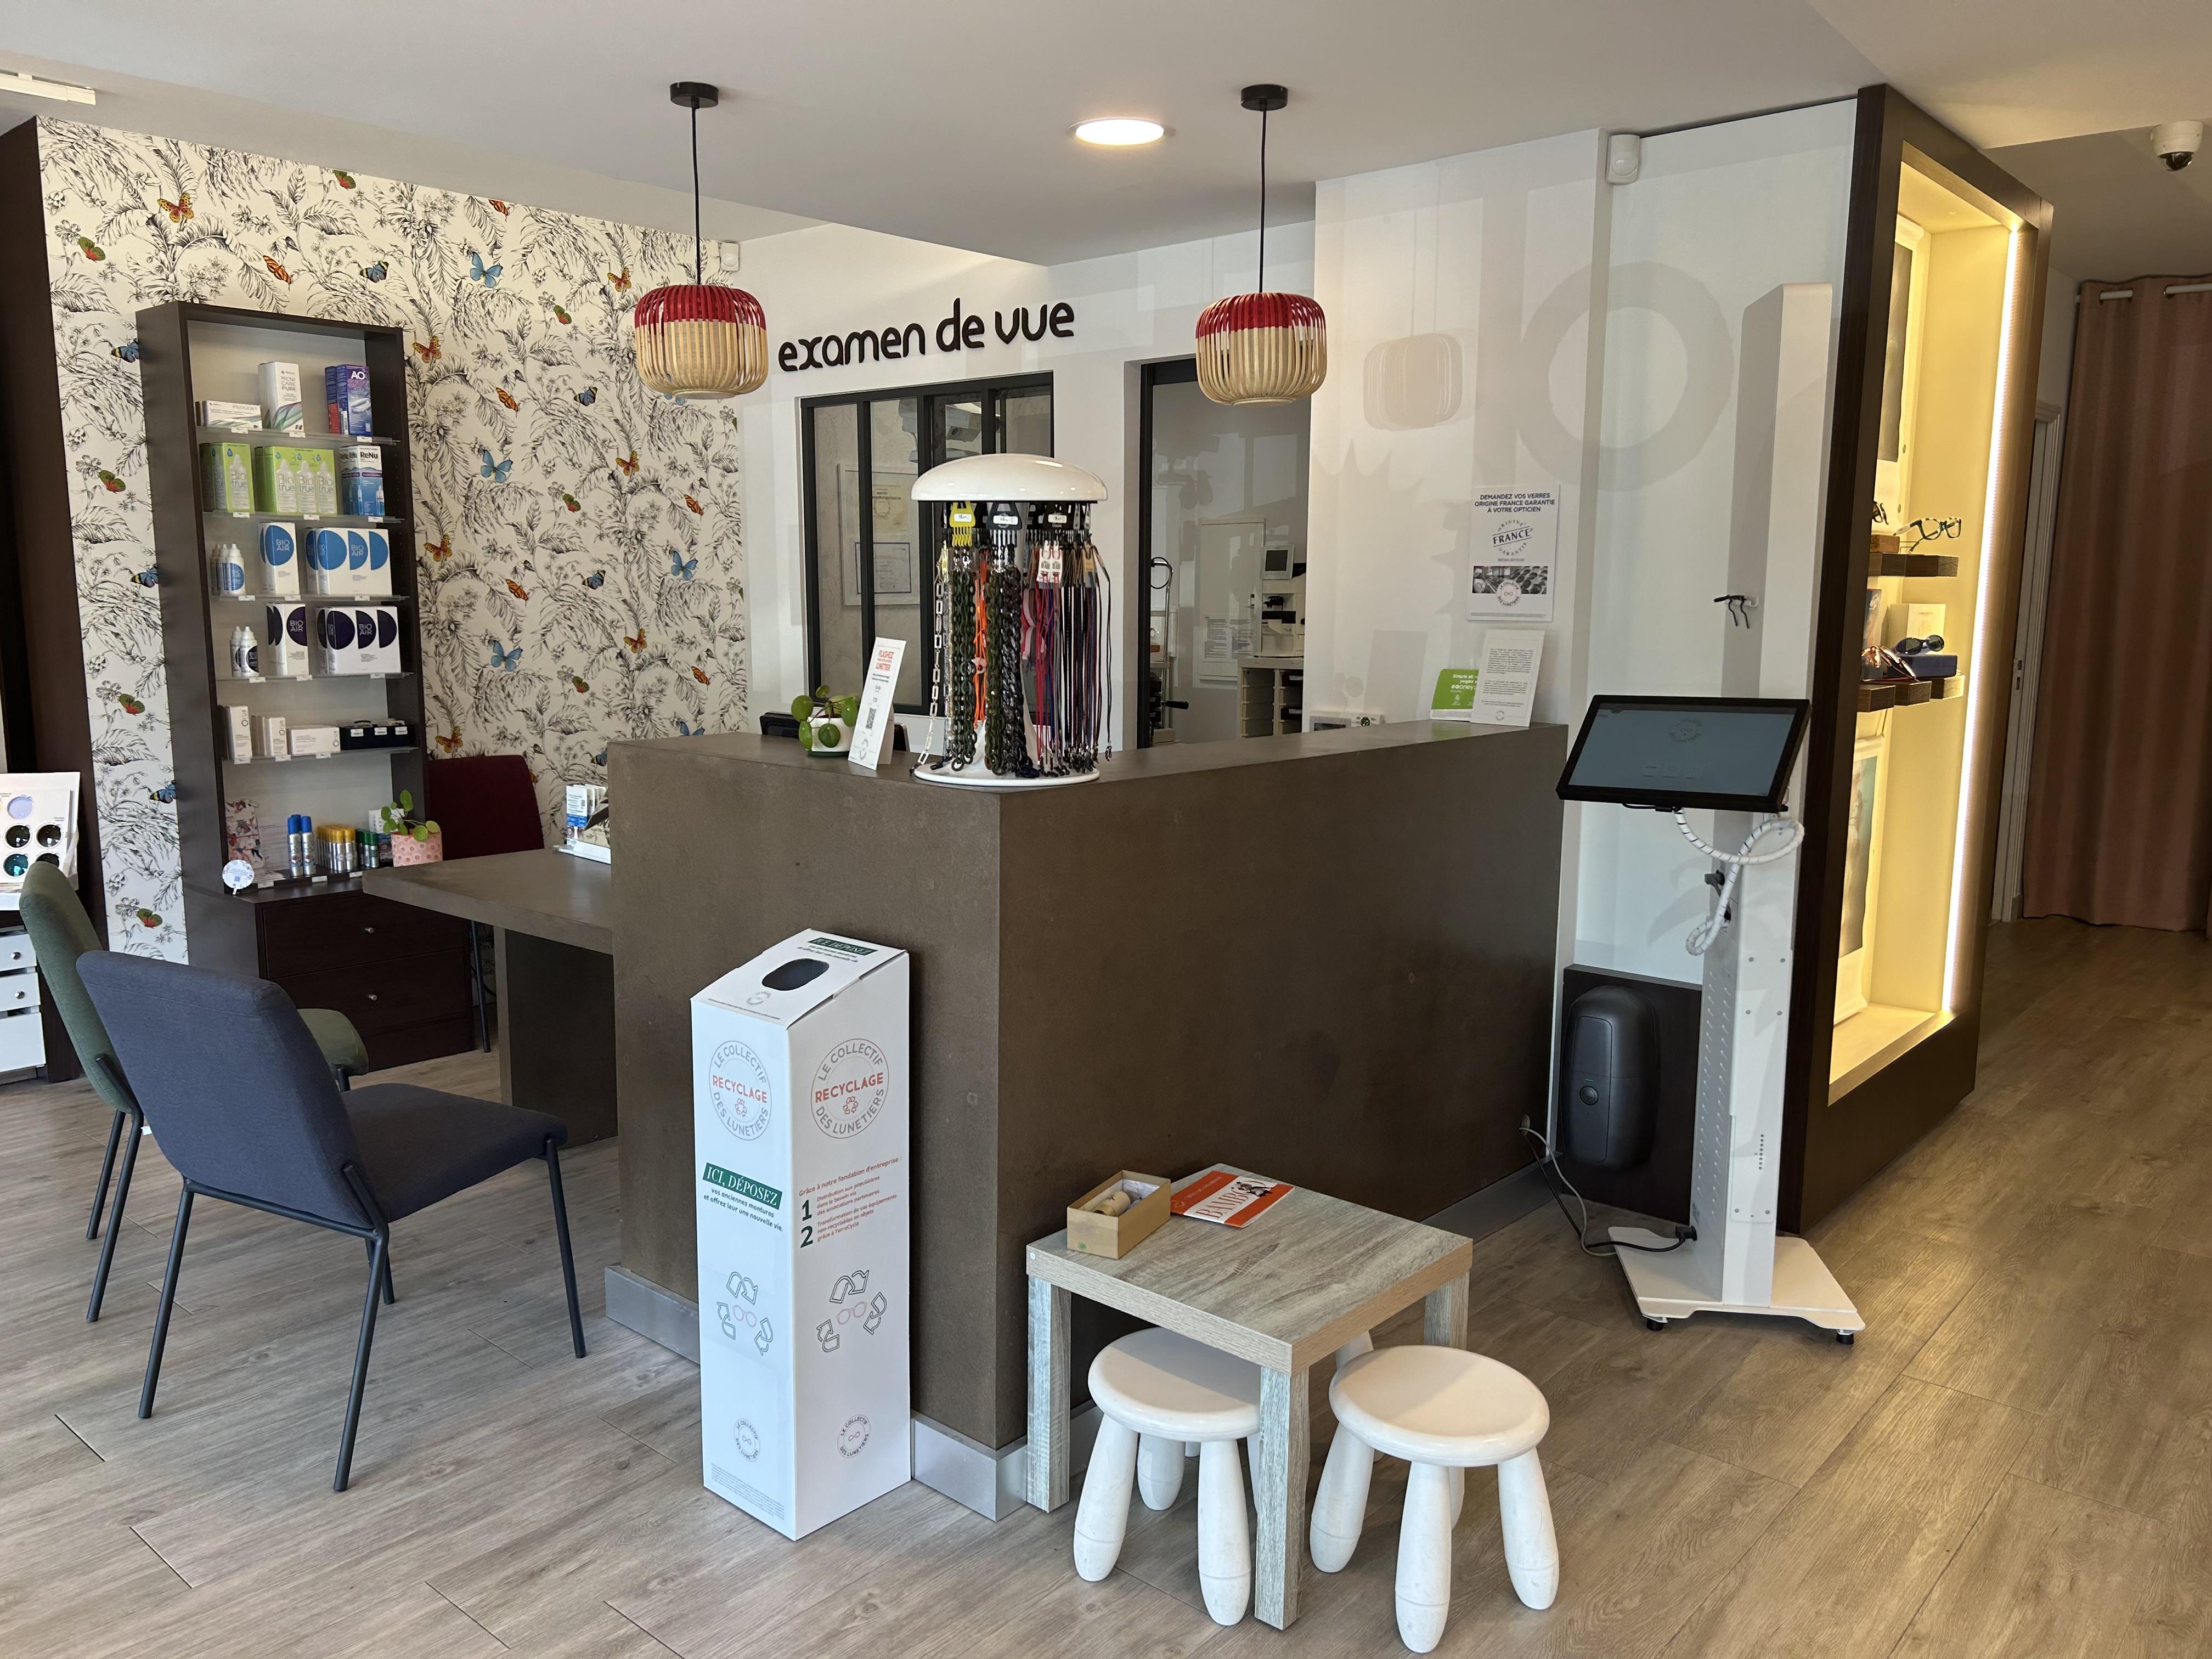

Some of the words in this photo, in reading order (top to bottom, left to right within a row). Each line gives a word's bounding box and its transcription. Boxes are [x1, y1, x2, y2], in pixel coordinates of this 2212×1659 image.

[778, 323, 926, 371] examen
[936, 297, 985, 352] de
[995, 302, 1075, 345] vue
[347, 379, 369, 388] SEPT
[351, 371, 365, 380] AO
[714, 1052, 725, 1069] LE
[724, 1045, 766, 1084] COLLECTIF
[818, 1063, 831, 1081] LE
[831, 1043, 883, 1065] COLLECTIF
[713, 1075, 767, 1104] RECYCLAGE
[815, 1072, 883, 1103] RECYCLAGE
[714, 1092, 726, 1117] DES
[727, 1107, 768, 1136] LUNETIERS
[816, 1106, 832, 1129] DES
[832, 1088, 884, 1134] LUNETIERS
[707, 1166, 725, 1187] ICI,
[727, 1175, 778, 1206] DÉPOSEZ
[799, 1187, 815, 1196] Grâce
[821, 1178, 837, 1188] notre
[838, 1169, 865, 1182] fondation
[866, 1158, 899, 1172] d'entreprise
[721, 1192, 747, 1206] anciennes
[749, 1203, 774, 1217] montures
[817, 1189, 844, 1201] Distribution
[710, 1197, 726, 1207] offrez
[727, 1203, 738, 1212] leur
[750, 1214, 772, 1227] nouvelle
[774, 1223, 783, 1232] vie.
[802, 1199, 812, 1221] 1
[817, 1211, 853, 1227] Transformation
[800, 1226, 813, 1248] 2
[835, 1222, 859, 1234] TerraCycle
[845, 1417, 868, 1427] COLLECTIF
[847, 1434, 869, 1457] LUNETIERS
